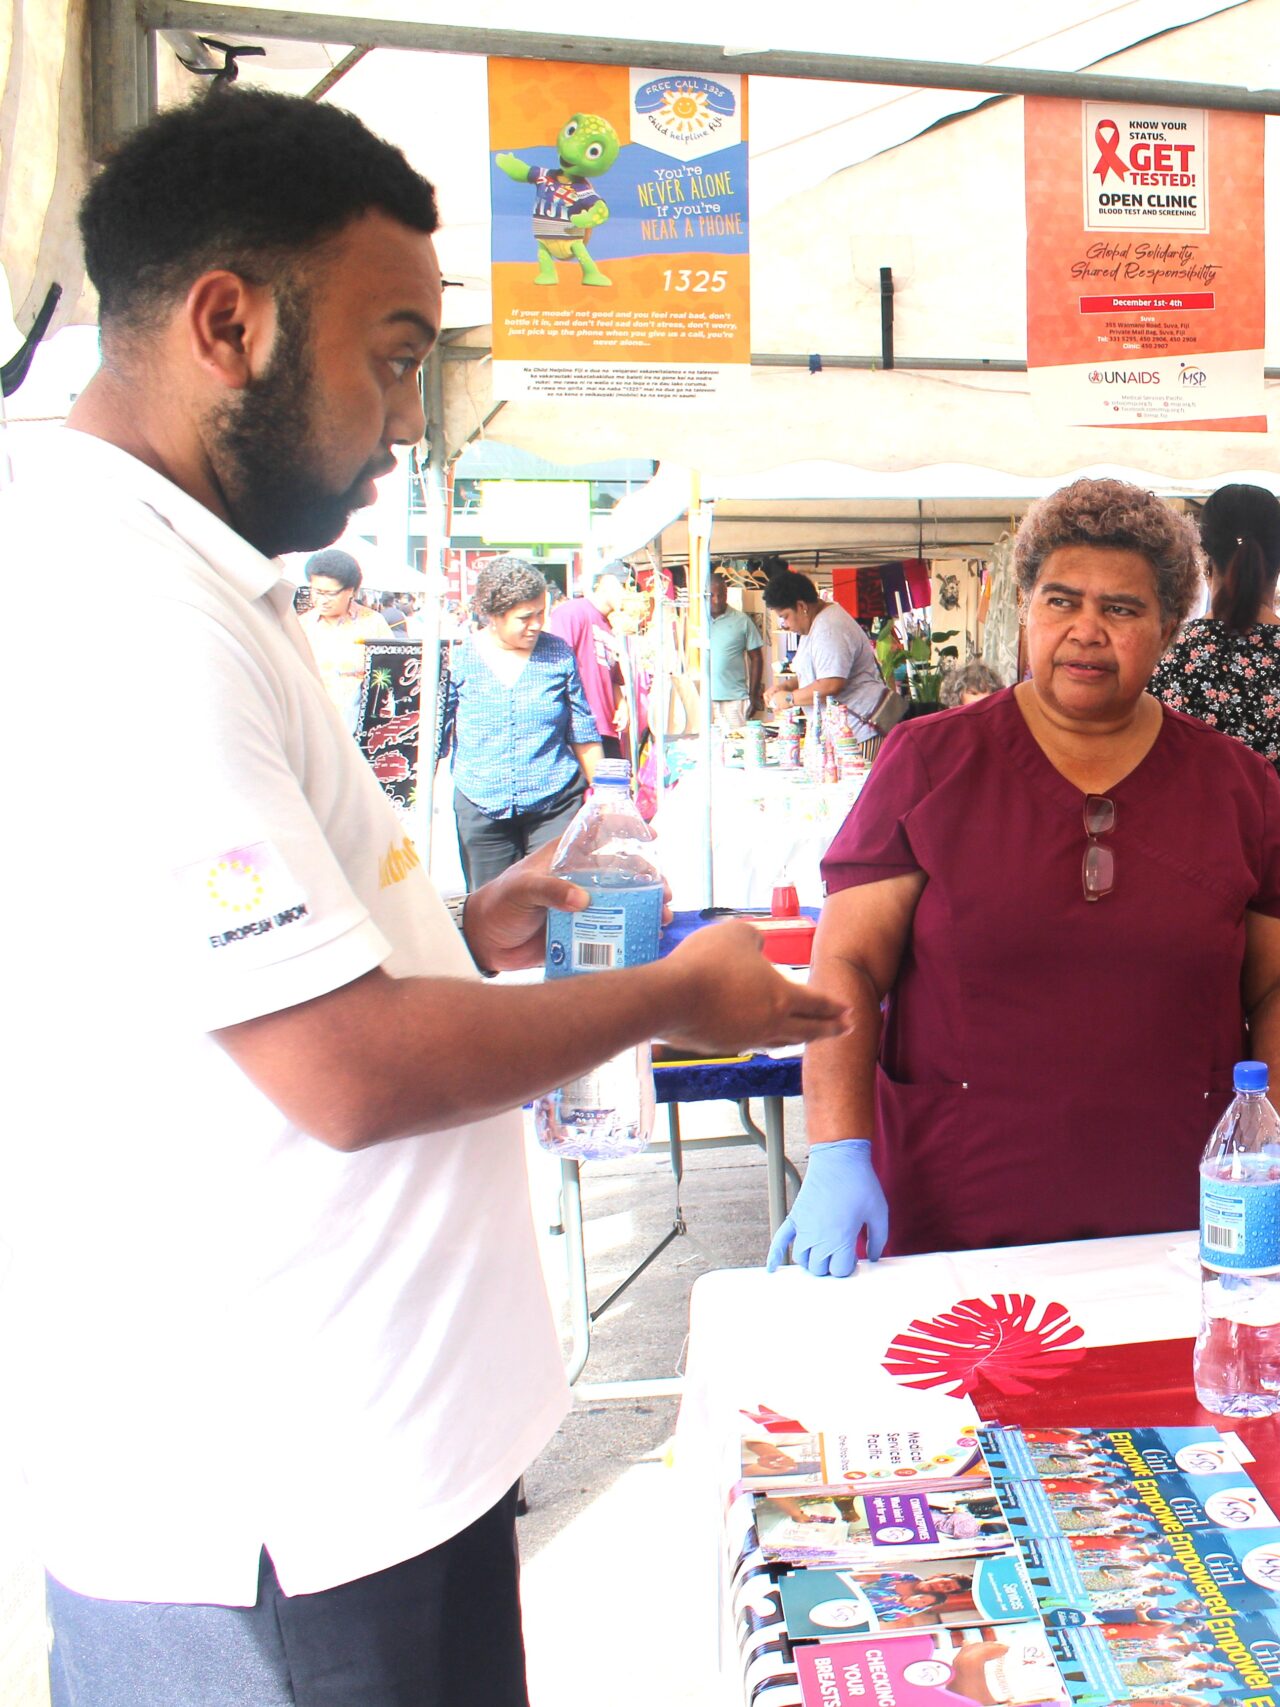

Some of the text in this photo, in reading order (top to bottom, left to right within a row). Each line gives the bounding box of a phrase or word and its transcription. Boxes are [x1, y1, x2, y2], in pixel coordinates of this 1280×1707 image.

[645, 81, 671, 95] FREE
[675, 80, 699, 88] CALL
[1129, 121, 1187, 131] KNOW YOUR
[1129, 132, 1167, 142] STATUS,
[1129, 143, 1195, 172] GET
[654, 165, 703, 181] You're
[1129, 172, 1196, 187] TESTED!
[637, 171, 734, 207] NEVER ALONE
[1099, 193, 1197, 209] OPEN CLINIC
[657, 202, 721, 219] If you're
[641, 213, 744, 240] NEAR A PHONE
[1086, 242, 1132, 261] Global
[663, 269, 728, 292] 1325
[1071, 261, 1223, 286] Shared Responsibility
[520, 310, 540, 318] your
[1113, 298, 1152, 307] December
[1169, 299, 1183, 307] 4th
[508, 328, 525, 336] just
[1104, 371, 1207, 386] UNAIDS MSP
[209, 903, 309, 948] EUROPEAN UNION
[867, 1433, 881, 1461] Pacific
[887, 1432, 902, 1465] Services
[907, 1431, 923, 1463] Medical
[1142, 1448, 1179, 1475] Girl
[1170, 1497, 1209, 1527] Girl
[1167, 1532, 1239, 1617] Empowered
[1205, 1553, 1246, 1586] Girl
[1003, 1583, 1024, 1610] Services
[814, 1657, 842, 1707] BREASTS
[842, 1663, 866, 1697] YOUR
[865, 1649, 896, 1707] CHECKING
